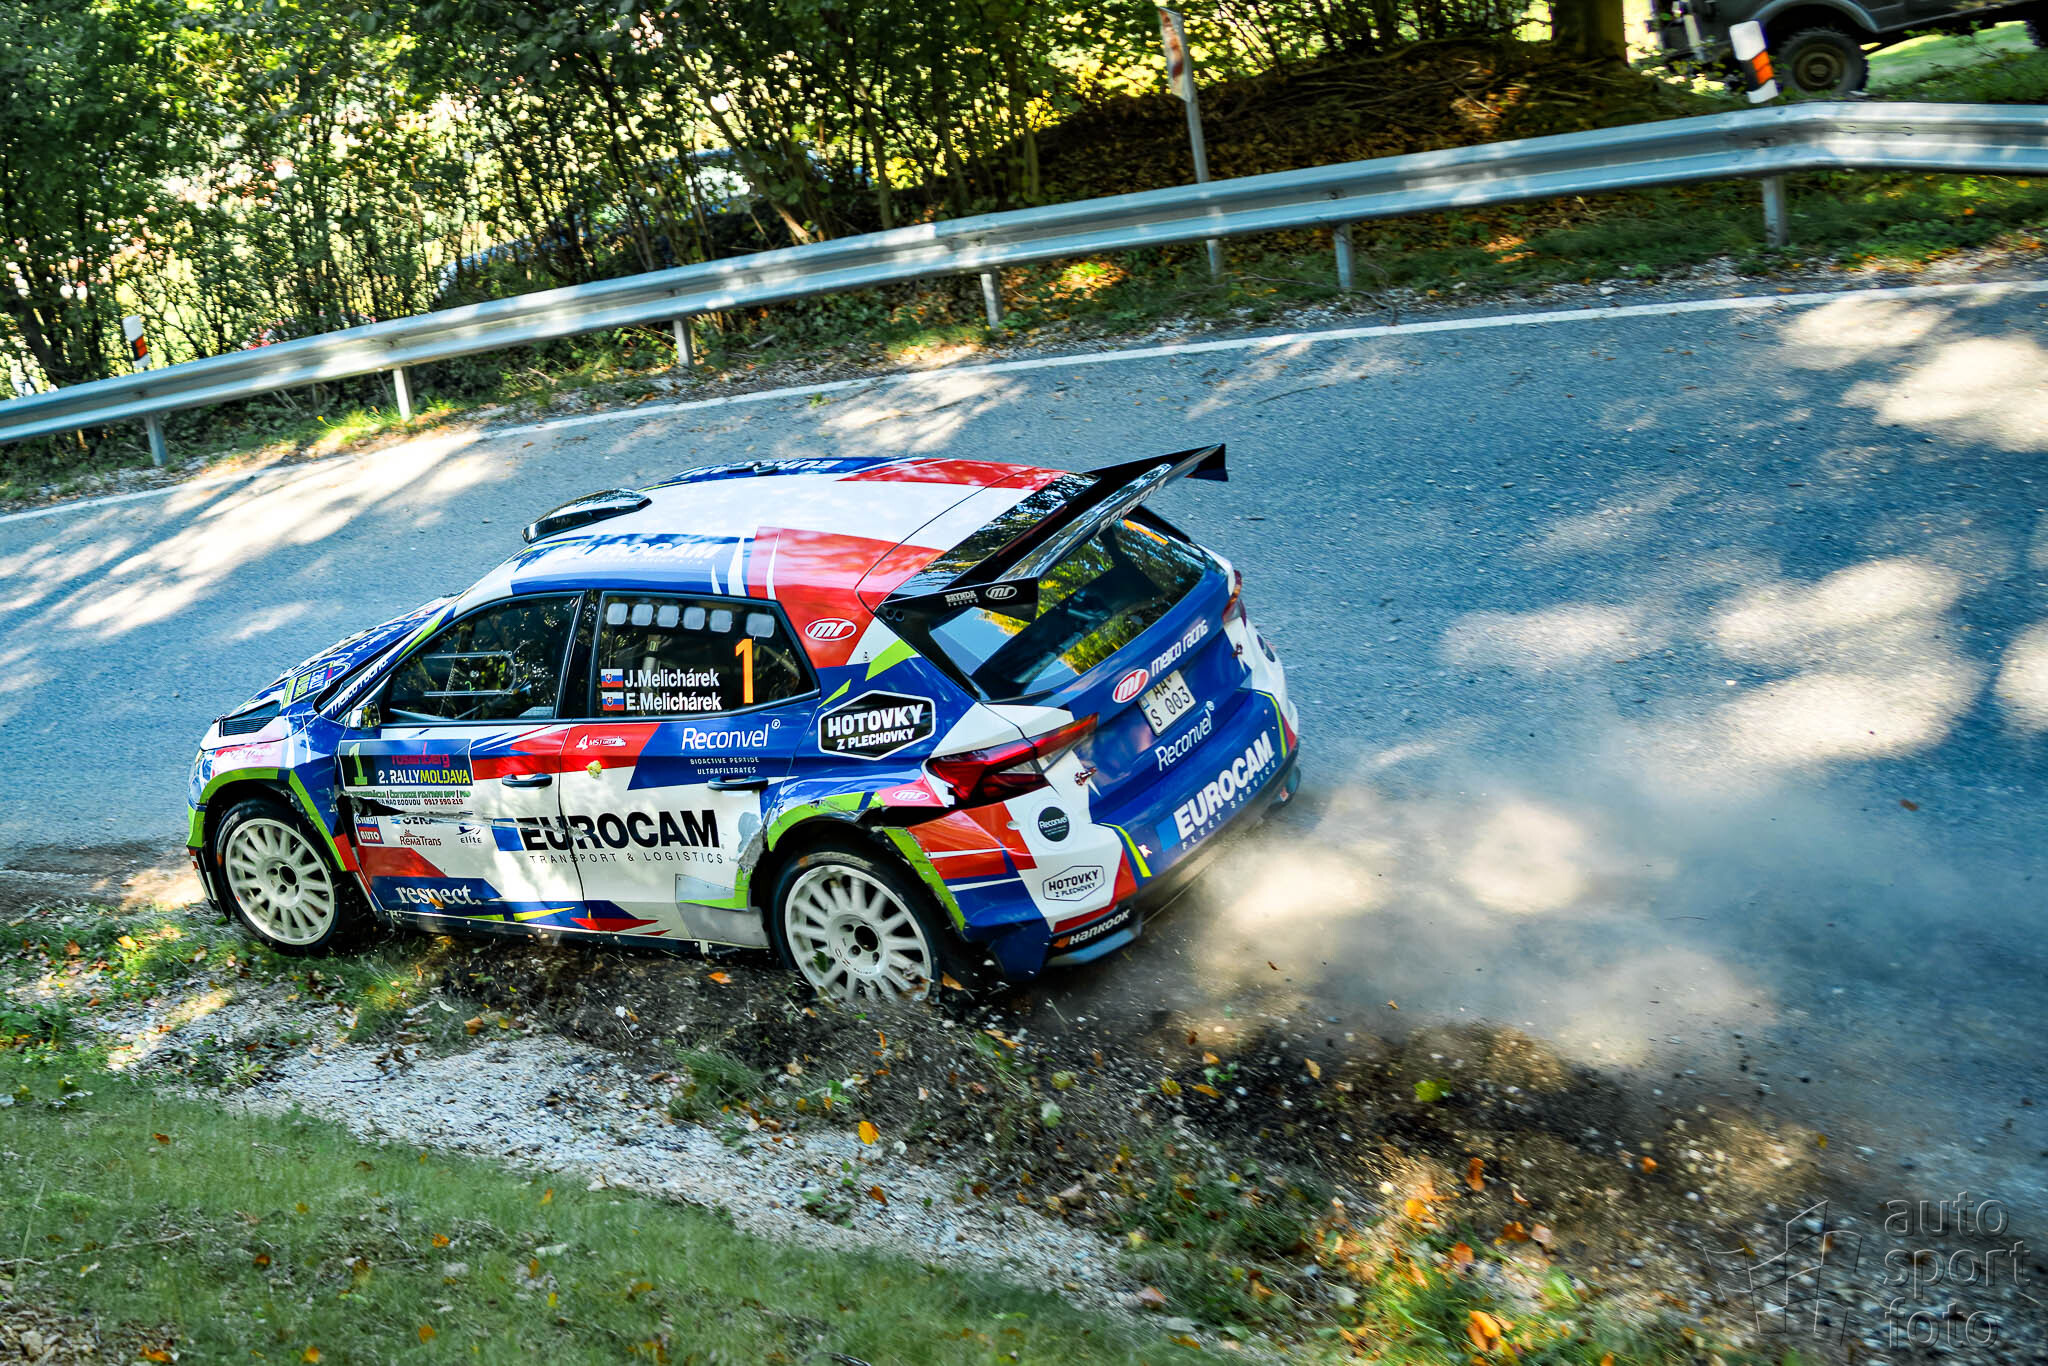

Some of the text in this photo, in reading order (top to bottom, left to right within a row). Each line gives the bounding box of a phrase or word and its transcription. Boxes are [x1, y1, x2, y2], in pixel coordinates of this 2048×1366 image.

[625, 667, 720, 688] J.Melichárek
[735, 638, 754, 704] 1
[626, 691, 723, 712] E.Melichárek
[1151, 685, 1190, 727] S 003
[827, 704, 924, 738] HOTOVKY
[837, 728, 914, 750] Z PLECHOVKY
[349, 743, 368, 785] 1
[690, 756, 760, 765] BIOACTIVE PEPTIDE
[697, 766, 757, 775] ULTRAFILTRATES
[378, 770, 389, 784] 2.
[1173, 730, 1275, 840] EUROCAM
[1182, 759, 1276, 850] FLEET SERVICE
[516, 809, 720, 850] EUROCAM
[530, 851, 724, 864] TRANSPORT & LOGISTICS
[1048, 870, 1099, 892] HOTOVKY
[1061, 882, 1096, 897] PLECHOVKY
